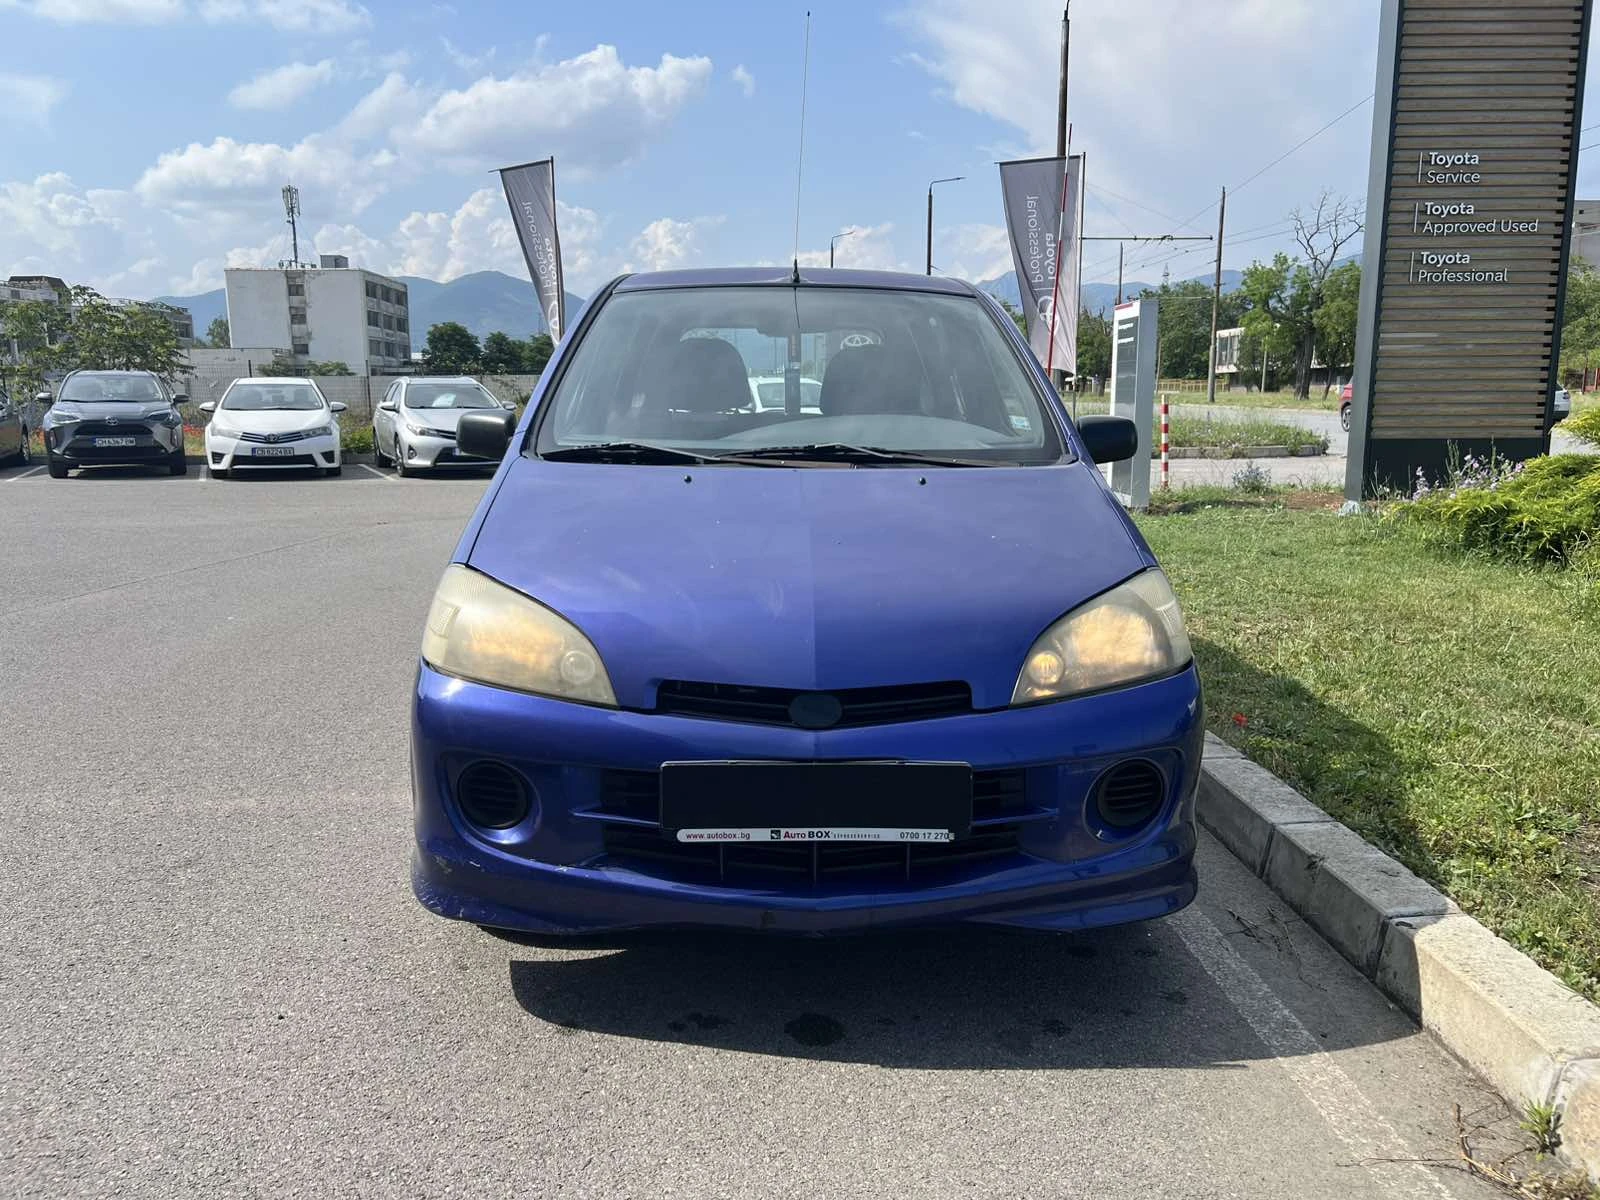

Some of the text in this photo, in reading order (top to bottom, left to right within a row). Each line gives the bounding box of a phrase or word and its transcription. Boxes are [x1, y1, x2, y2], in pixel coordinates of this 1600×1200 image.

[1428, 151, 1479, 168] Toyota
[1426, 170, 1480, 183] Service
[1424, 202, 1474, 218] Toyota
[1422, 218, 1539, 236] Approved Used
[1420, 251, 1470, 267] Toyota
[1418, 268, 1508, 283] Professional
[686, 831, 750, 840] www.autobox.bg
[784, 831, 806, 839] Auto
[808, 831, 831, 839] BOX
[900, 831, 919, 840] 0700
[922, 832, 931, 840] 17
[934, 832, 949, 840] 270
